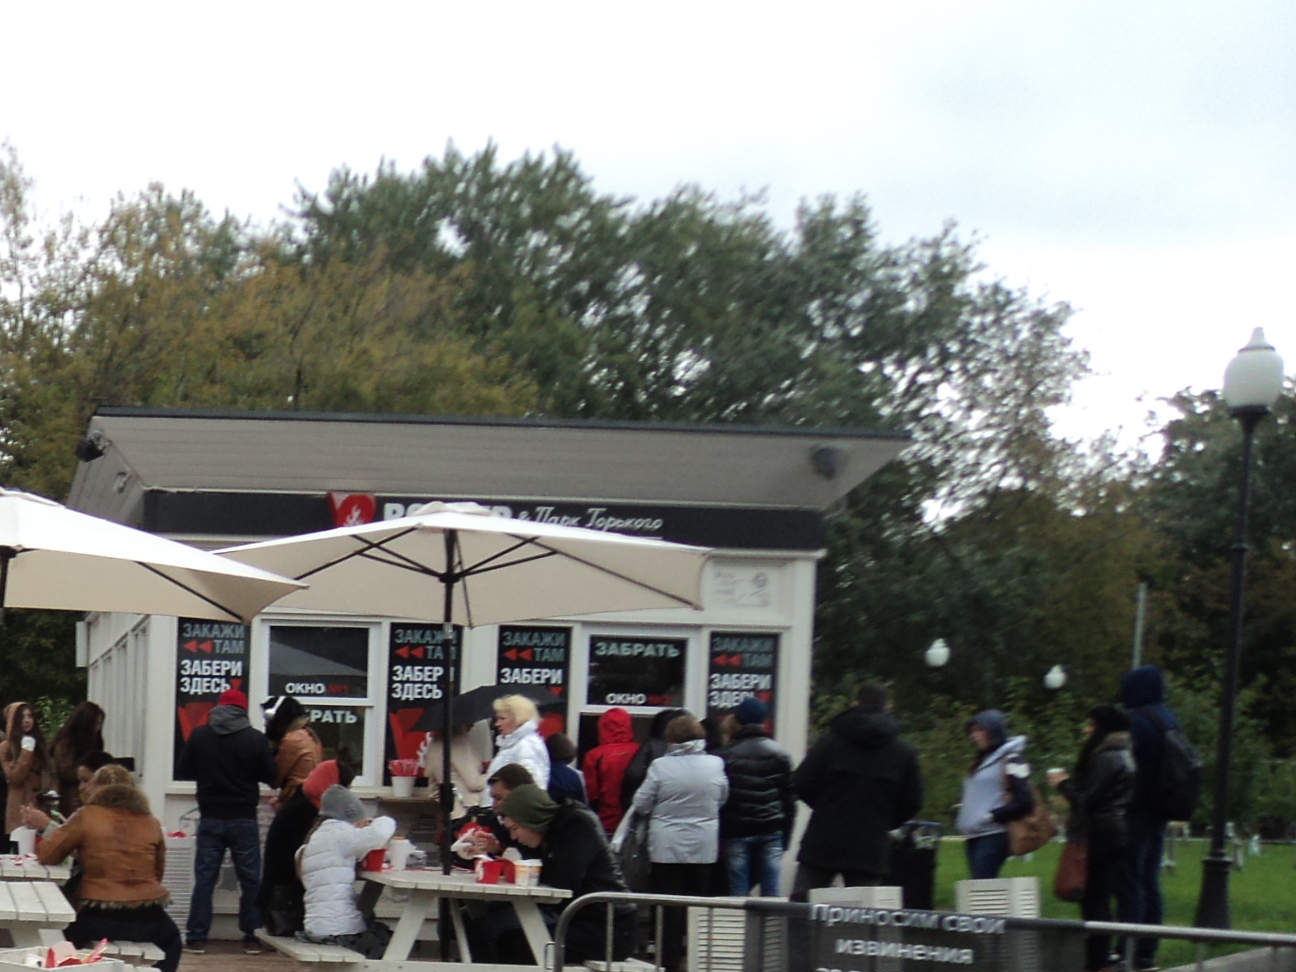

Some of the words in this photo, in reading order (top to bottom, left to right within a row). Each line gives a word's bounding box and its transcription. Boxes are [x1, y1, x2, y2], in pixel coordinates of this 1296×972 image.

[585, 507, 663, 532] Горького
[183, 623, 245, 639] ЗАКАЖИ
[502, 631, 565, 647] ЗАКАЖИ
[213, 639, 245, 654] ТАМ
[534, 647, 564, 662] ТАМ
[595, 642, 680, 657] ЗАБРАТЬ
[180, 659, 242, 677] ЗАБЕРИ
[500, 668, 563, 684] ЗАБЕРИ
[180, 677, 231, 695] ЗДЕСЬ
[285, 682, 325, 694] ОКНО
[710, 673, 771, 689] ЗАБЕРИ
[391, 683, 443, 700] ЗДЕСЬ
[606, 693, 646, 705] ОКНО
[305, 709, 358, 724] РАТЬ
[811, 903, 940, 929] Приносим
[942, 915, 1006, 934] свои
[835, 938, 974, 964] извинения
